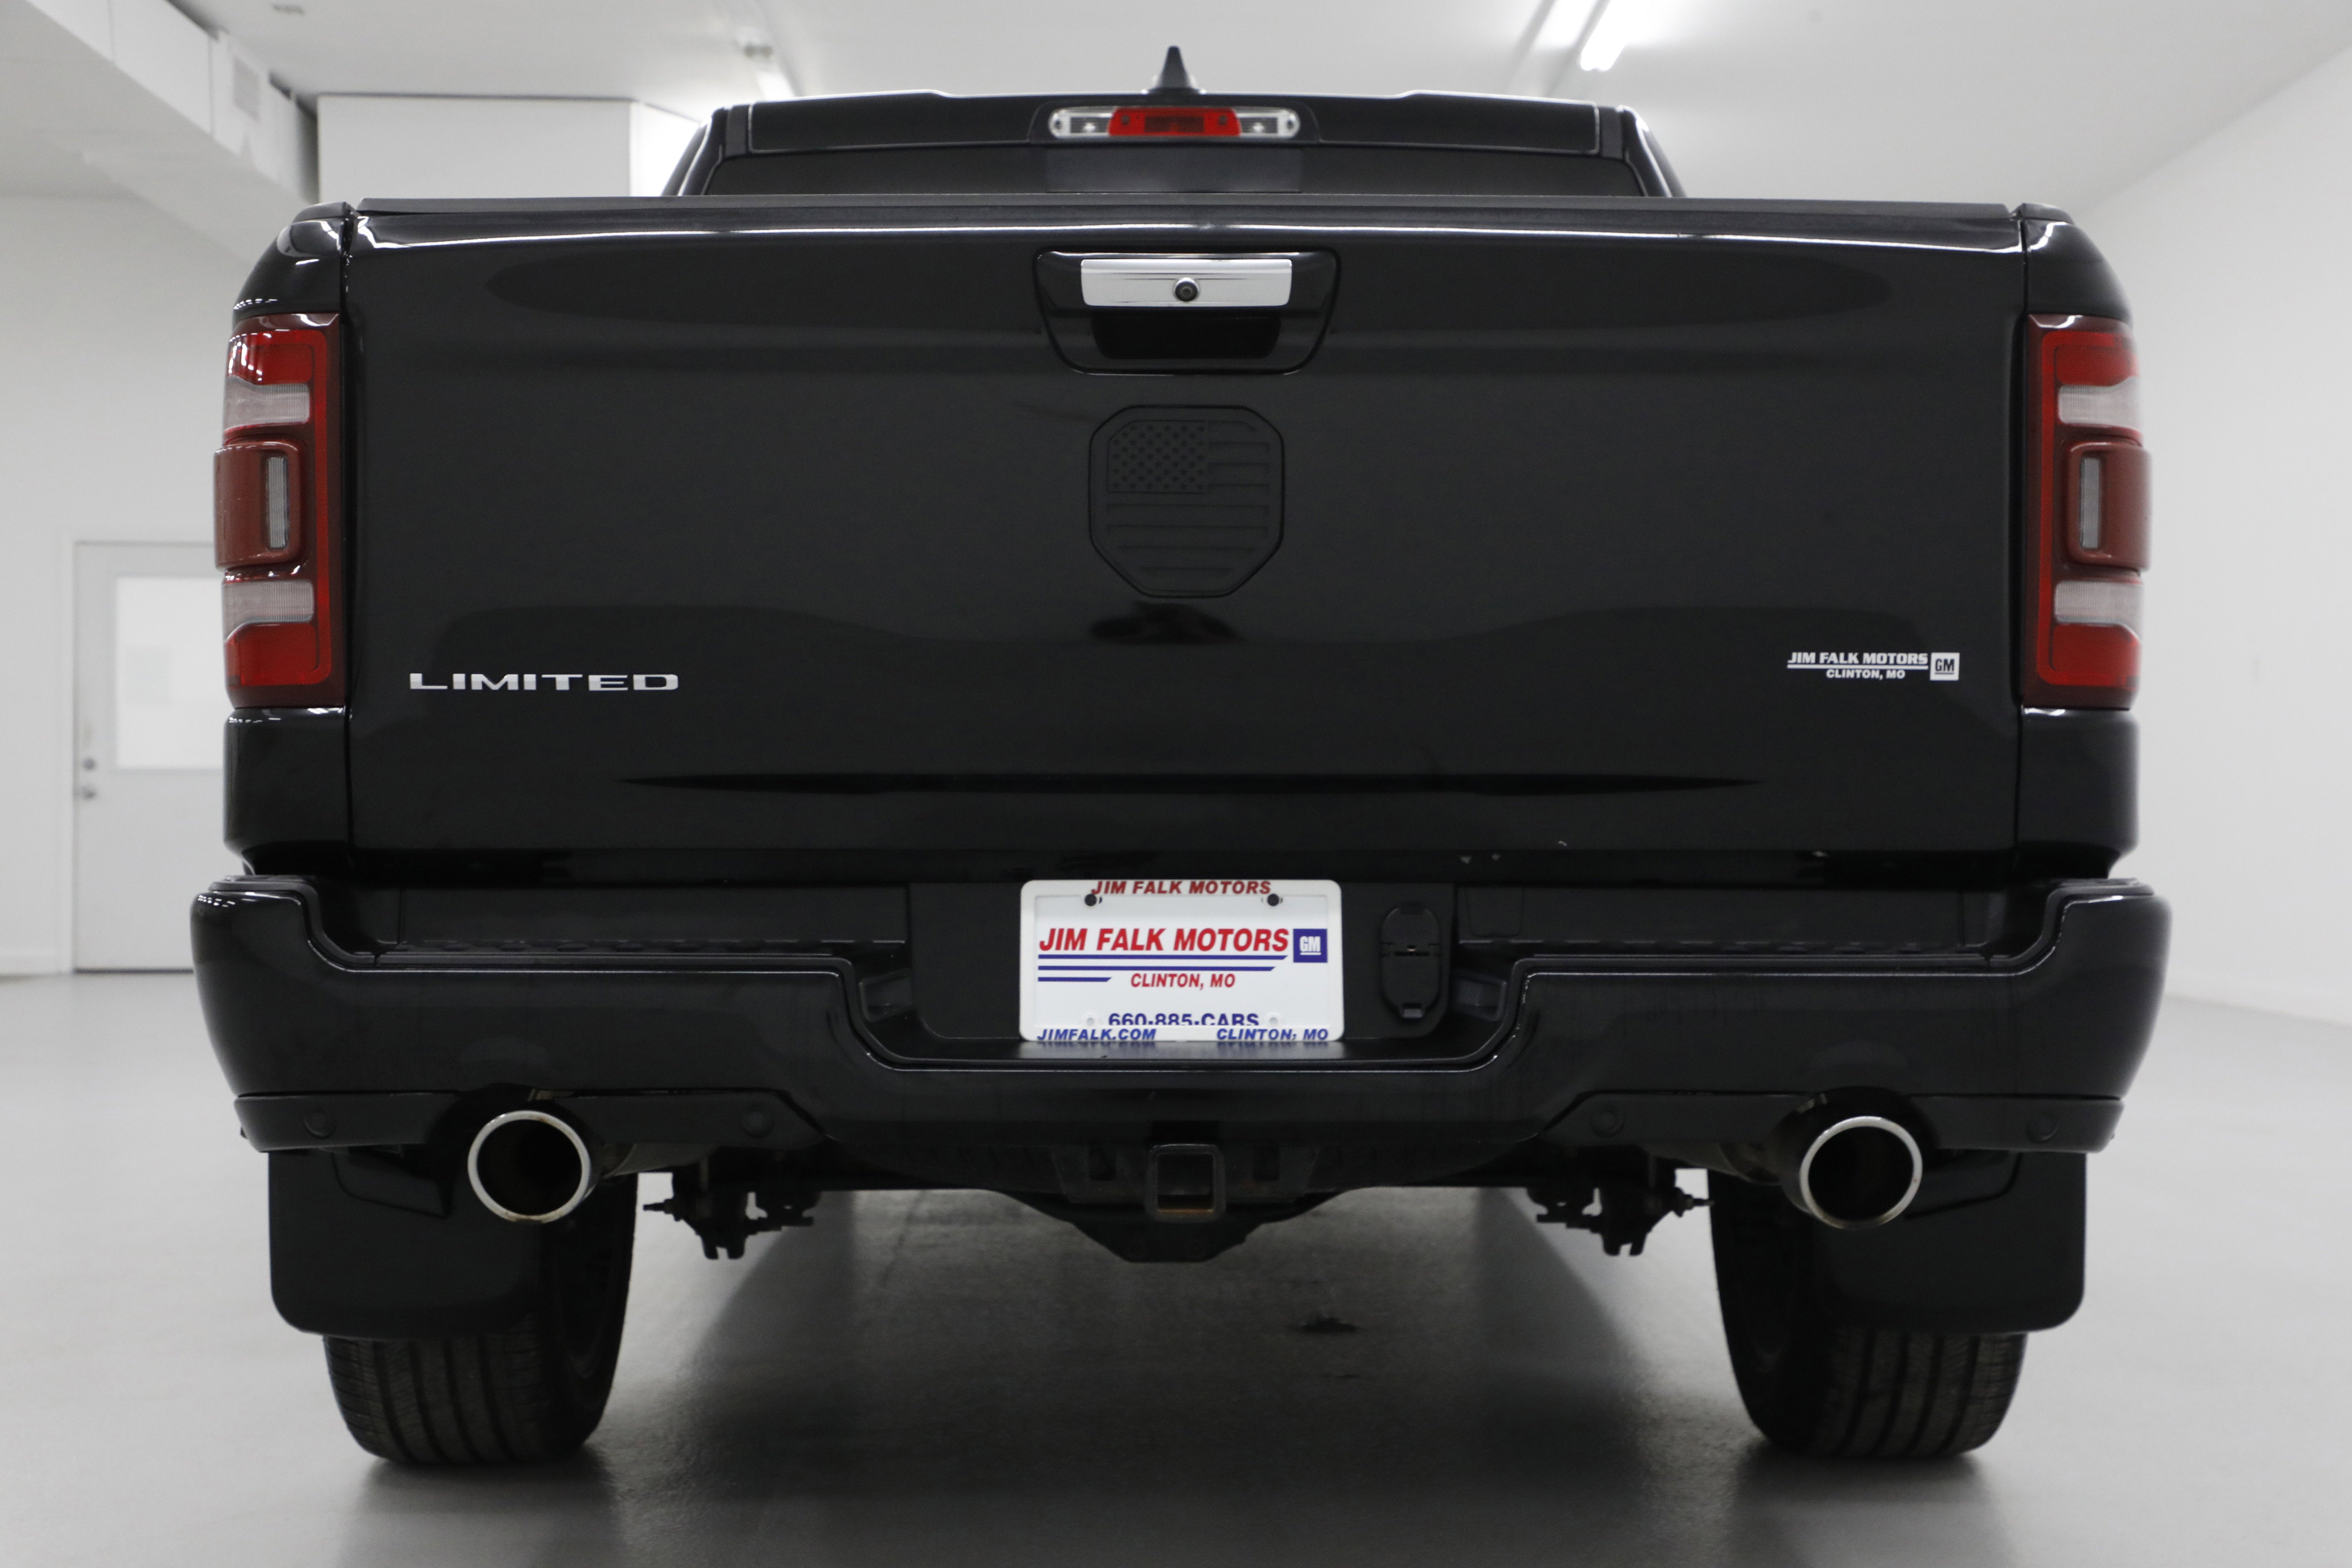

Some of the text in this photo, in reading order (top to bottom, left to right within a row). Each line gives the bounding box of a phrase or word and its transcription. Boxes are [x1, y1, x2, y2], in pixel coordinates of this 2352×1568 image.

[1787, 652, 1928, 664] JIM FALK MOTORS
[1935, 658, 1955, 675] GM
[410, 673, 679, 691] LIMITED
[1826, 669, 1906, 680] CLINTON, MO
[1091, 881, 1271, 894] JIM FALK MOTORS
[1039, 928, 1289, 952] JIM FALK MOTORS
[1299, 935, 1321, 956] GM
[1130, 973, 1236, 990] CLINTON, MO
[1037, 1029, 1156, 1040] JIMFALK.COM
[1217, 1028, 1329, 1040] CLINTON, MO
